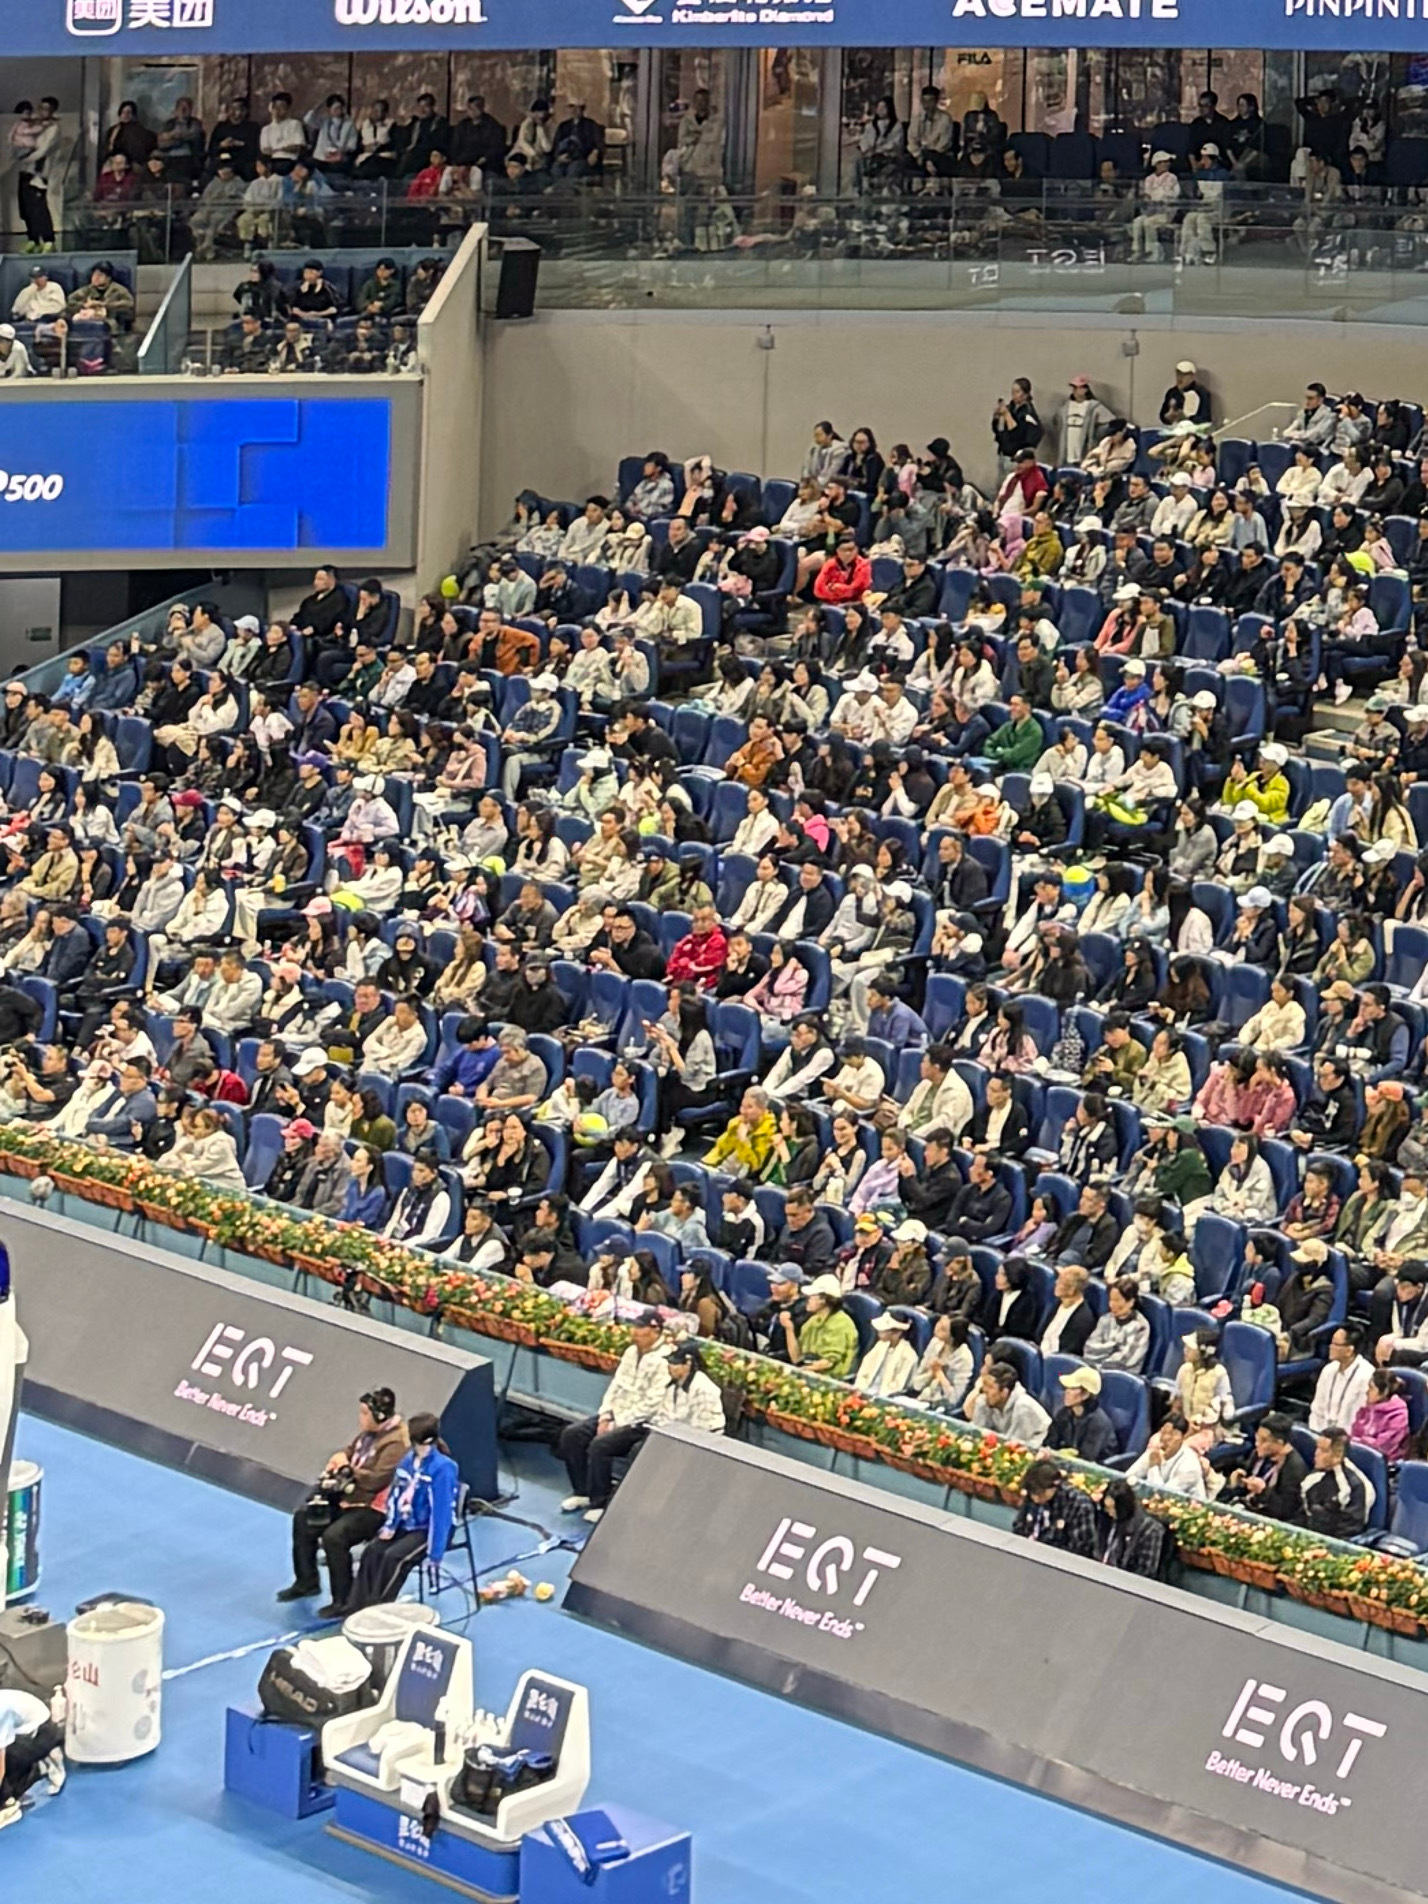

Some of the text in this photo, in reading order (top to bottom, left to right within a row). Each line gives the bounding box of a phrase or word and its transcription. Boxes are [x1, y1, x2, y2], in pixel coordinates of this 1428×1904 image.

[0, 469, 64, 502] 500
[191, 1322, 314, 1399] EQT
[757, 1518, 901, 1606] EQT
[740, 1583, 783, 1611] Better
[780, 1598, 821, 1625] Never
[1222, 1679, 1387, 1779] EQT
[1205, 1750, 1340, 1815] Better Never Ends
